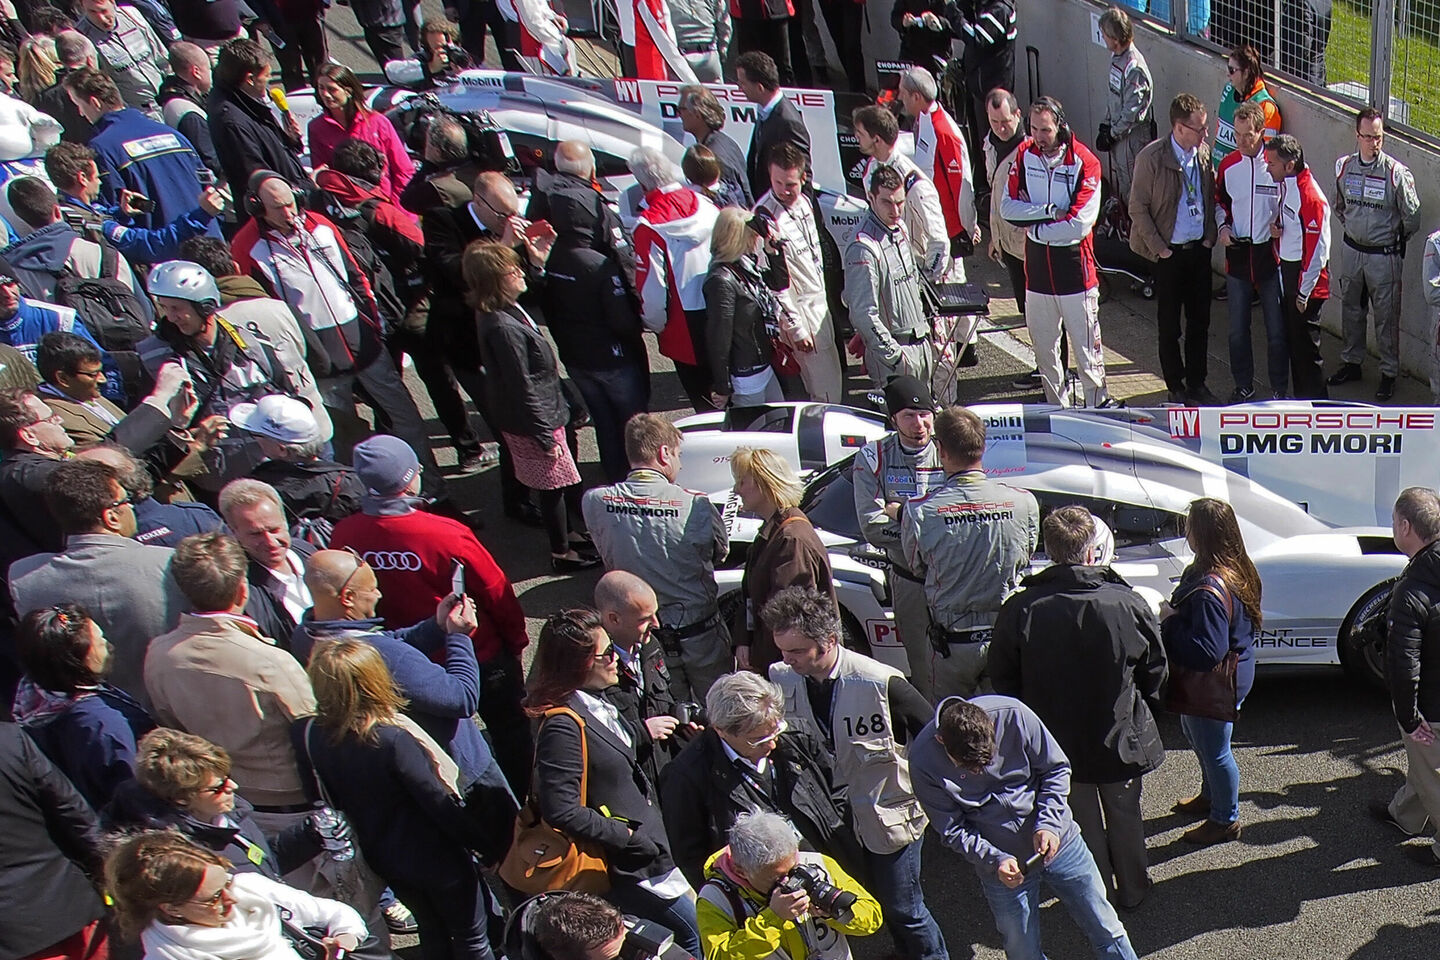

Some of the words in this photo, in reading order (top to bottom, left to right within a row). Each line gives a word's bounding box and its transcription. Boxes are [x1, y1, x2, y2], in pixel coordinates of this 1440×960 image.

[462, 77, 490, 86] Mobil
[616, 82, 640, 103] HY
[983, 416, 1007, 427] obil
[1169, 410, 1199, 438] HY
[1220, 412, 1434, 430] PORSCHE
[1221, 433, 1303, 455] DMG
[1310, 433, 1402, 455] MORI
[606, 504, 639, 516] DMG
[640, 505, 679, 518] MORI
[943, 515, 977, 526] DMG
[979, 510, 1014, 523] MORI
[843, 713, 885, 737] 168
